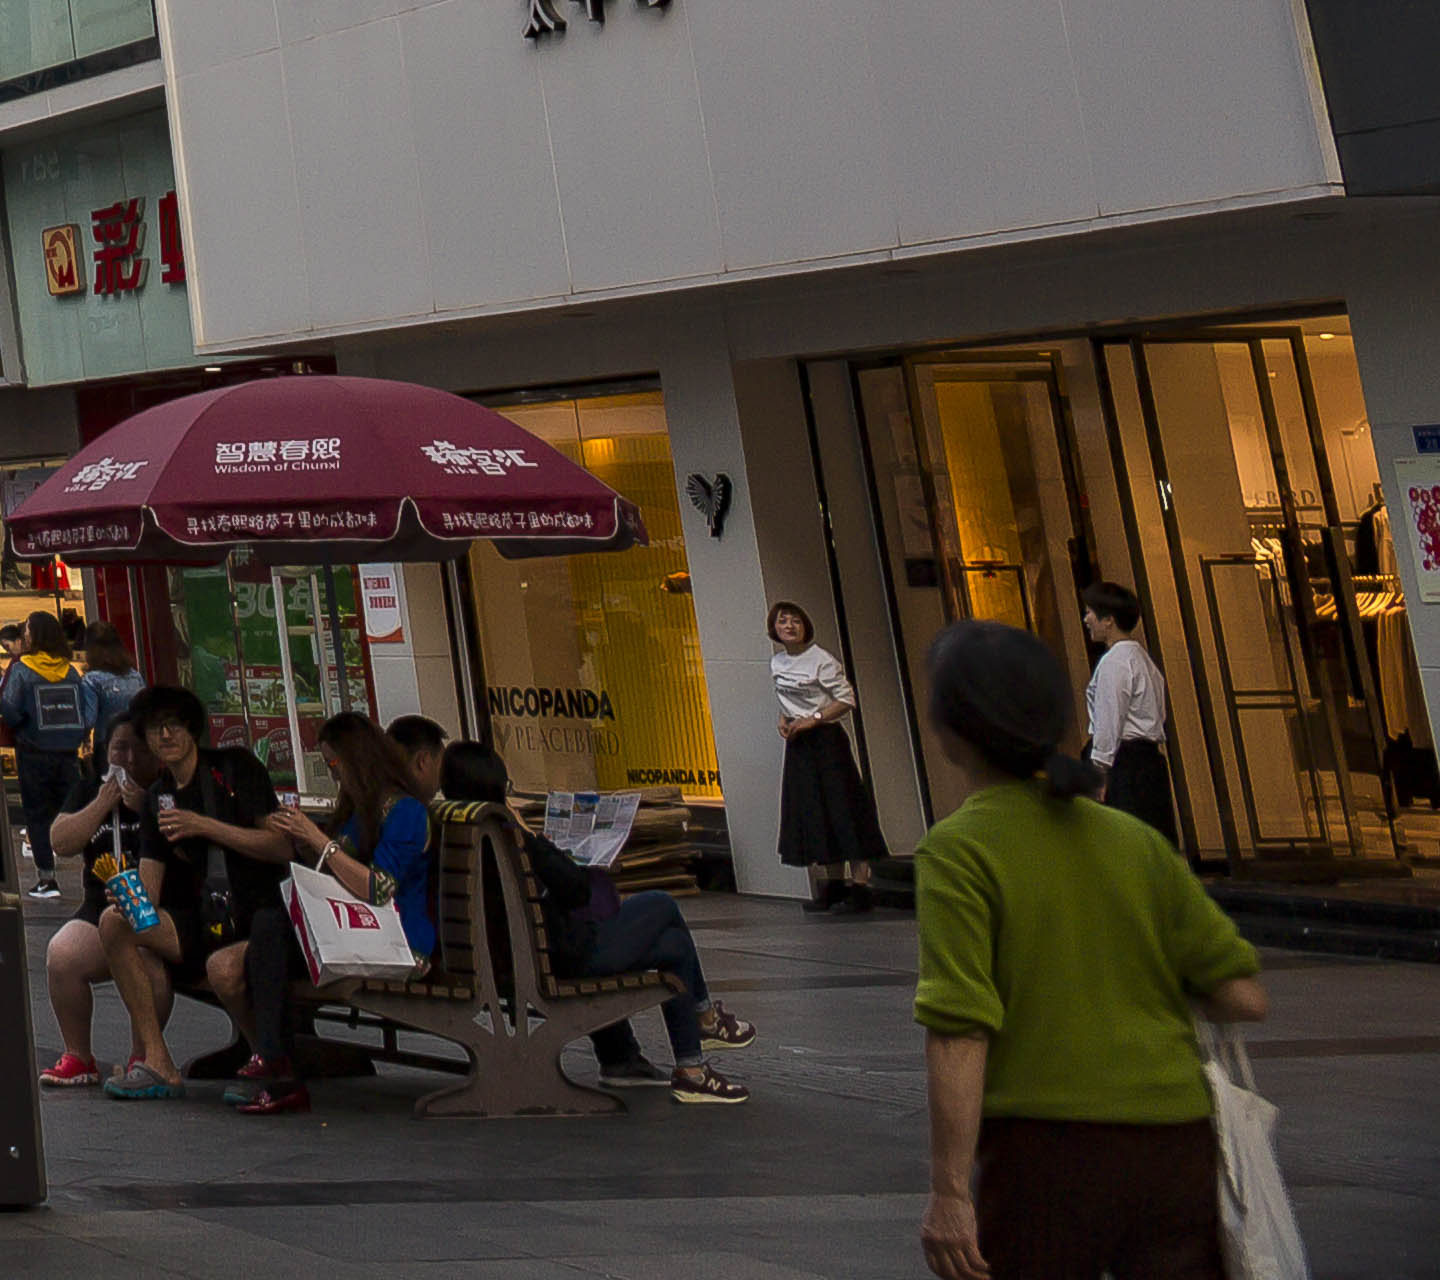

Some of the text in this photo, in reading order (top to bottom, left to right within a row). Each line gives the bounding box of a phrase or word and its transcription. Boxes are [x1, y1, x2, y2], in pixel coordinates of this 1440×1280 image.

[215, 437, 341, 464] 智慧春熙
[214, 459, 341, 474] Wisdom of Chunxi
[487, 687, 616, 721] NICOPANDA
[515, 724, 620, 756] PEACEBIRD
[626, 768, 697, 785] NICOPANDA
